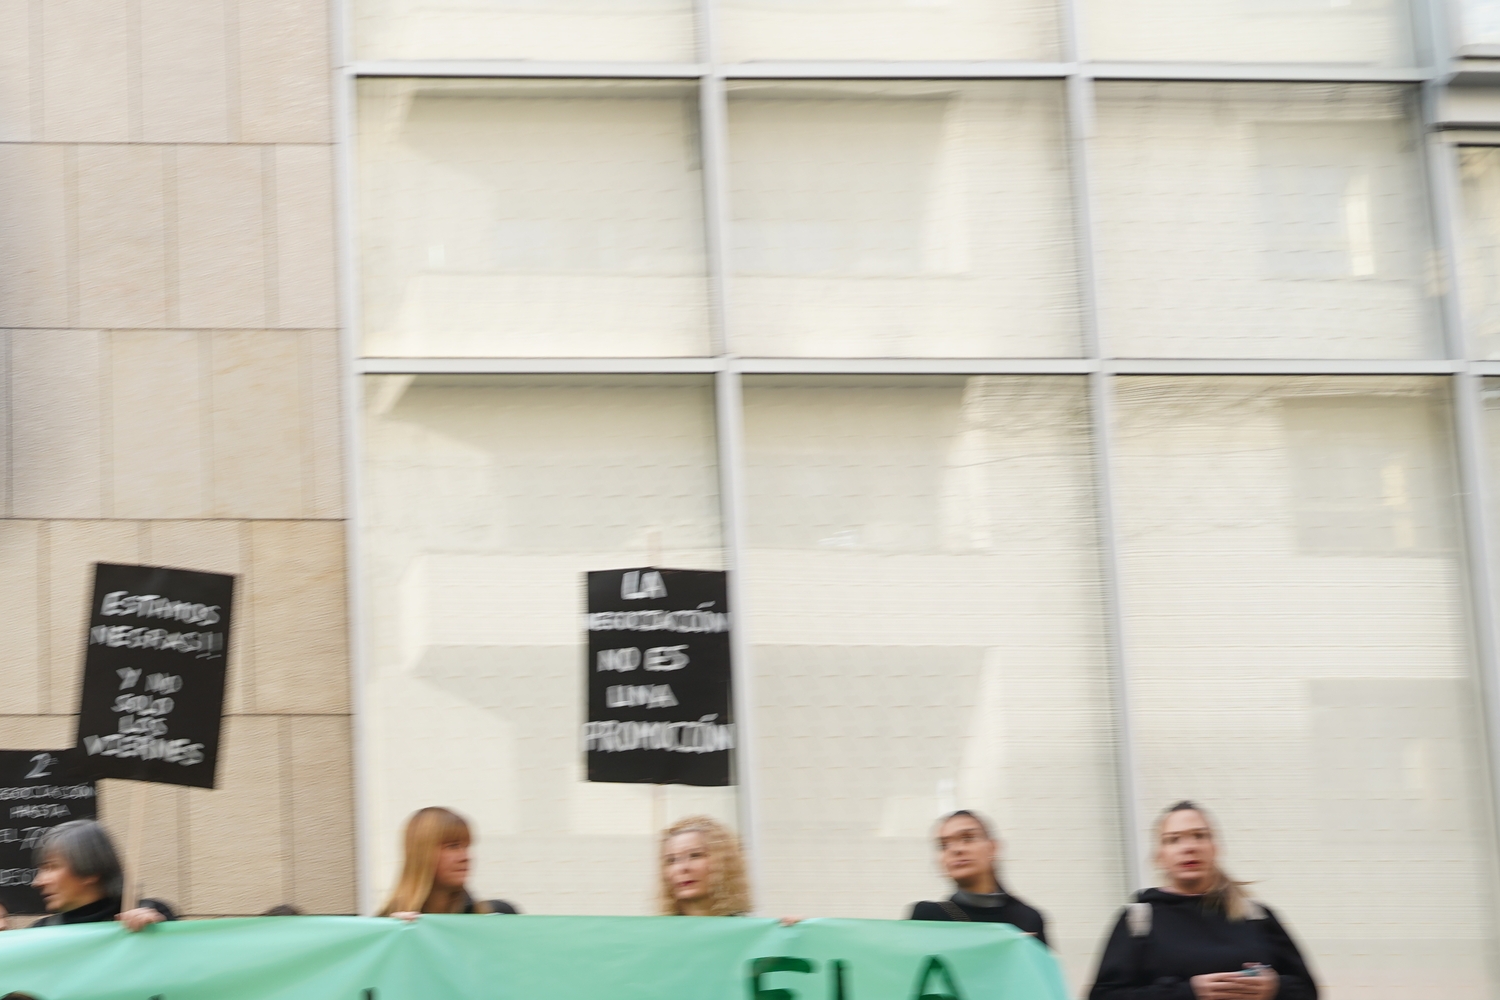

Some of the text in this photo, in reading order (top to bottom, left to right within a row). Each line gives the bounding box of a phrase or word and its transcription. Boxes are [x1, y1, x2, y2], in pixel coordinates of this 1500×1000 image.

[620, 570, 668, 600] LA
[101, 591, 221, 626] ESTAMOS
[597, 643, 690, 673] NO ES
[144, 672, 183, 695] NO
[606, 683, 679, 709] UNA
